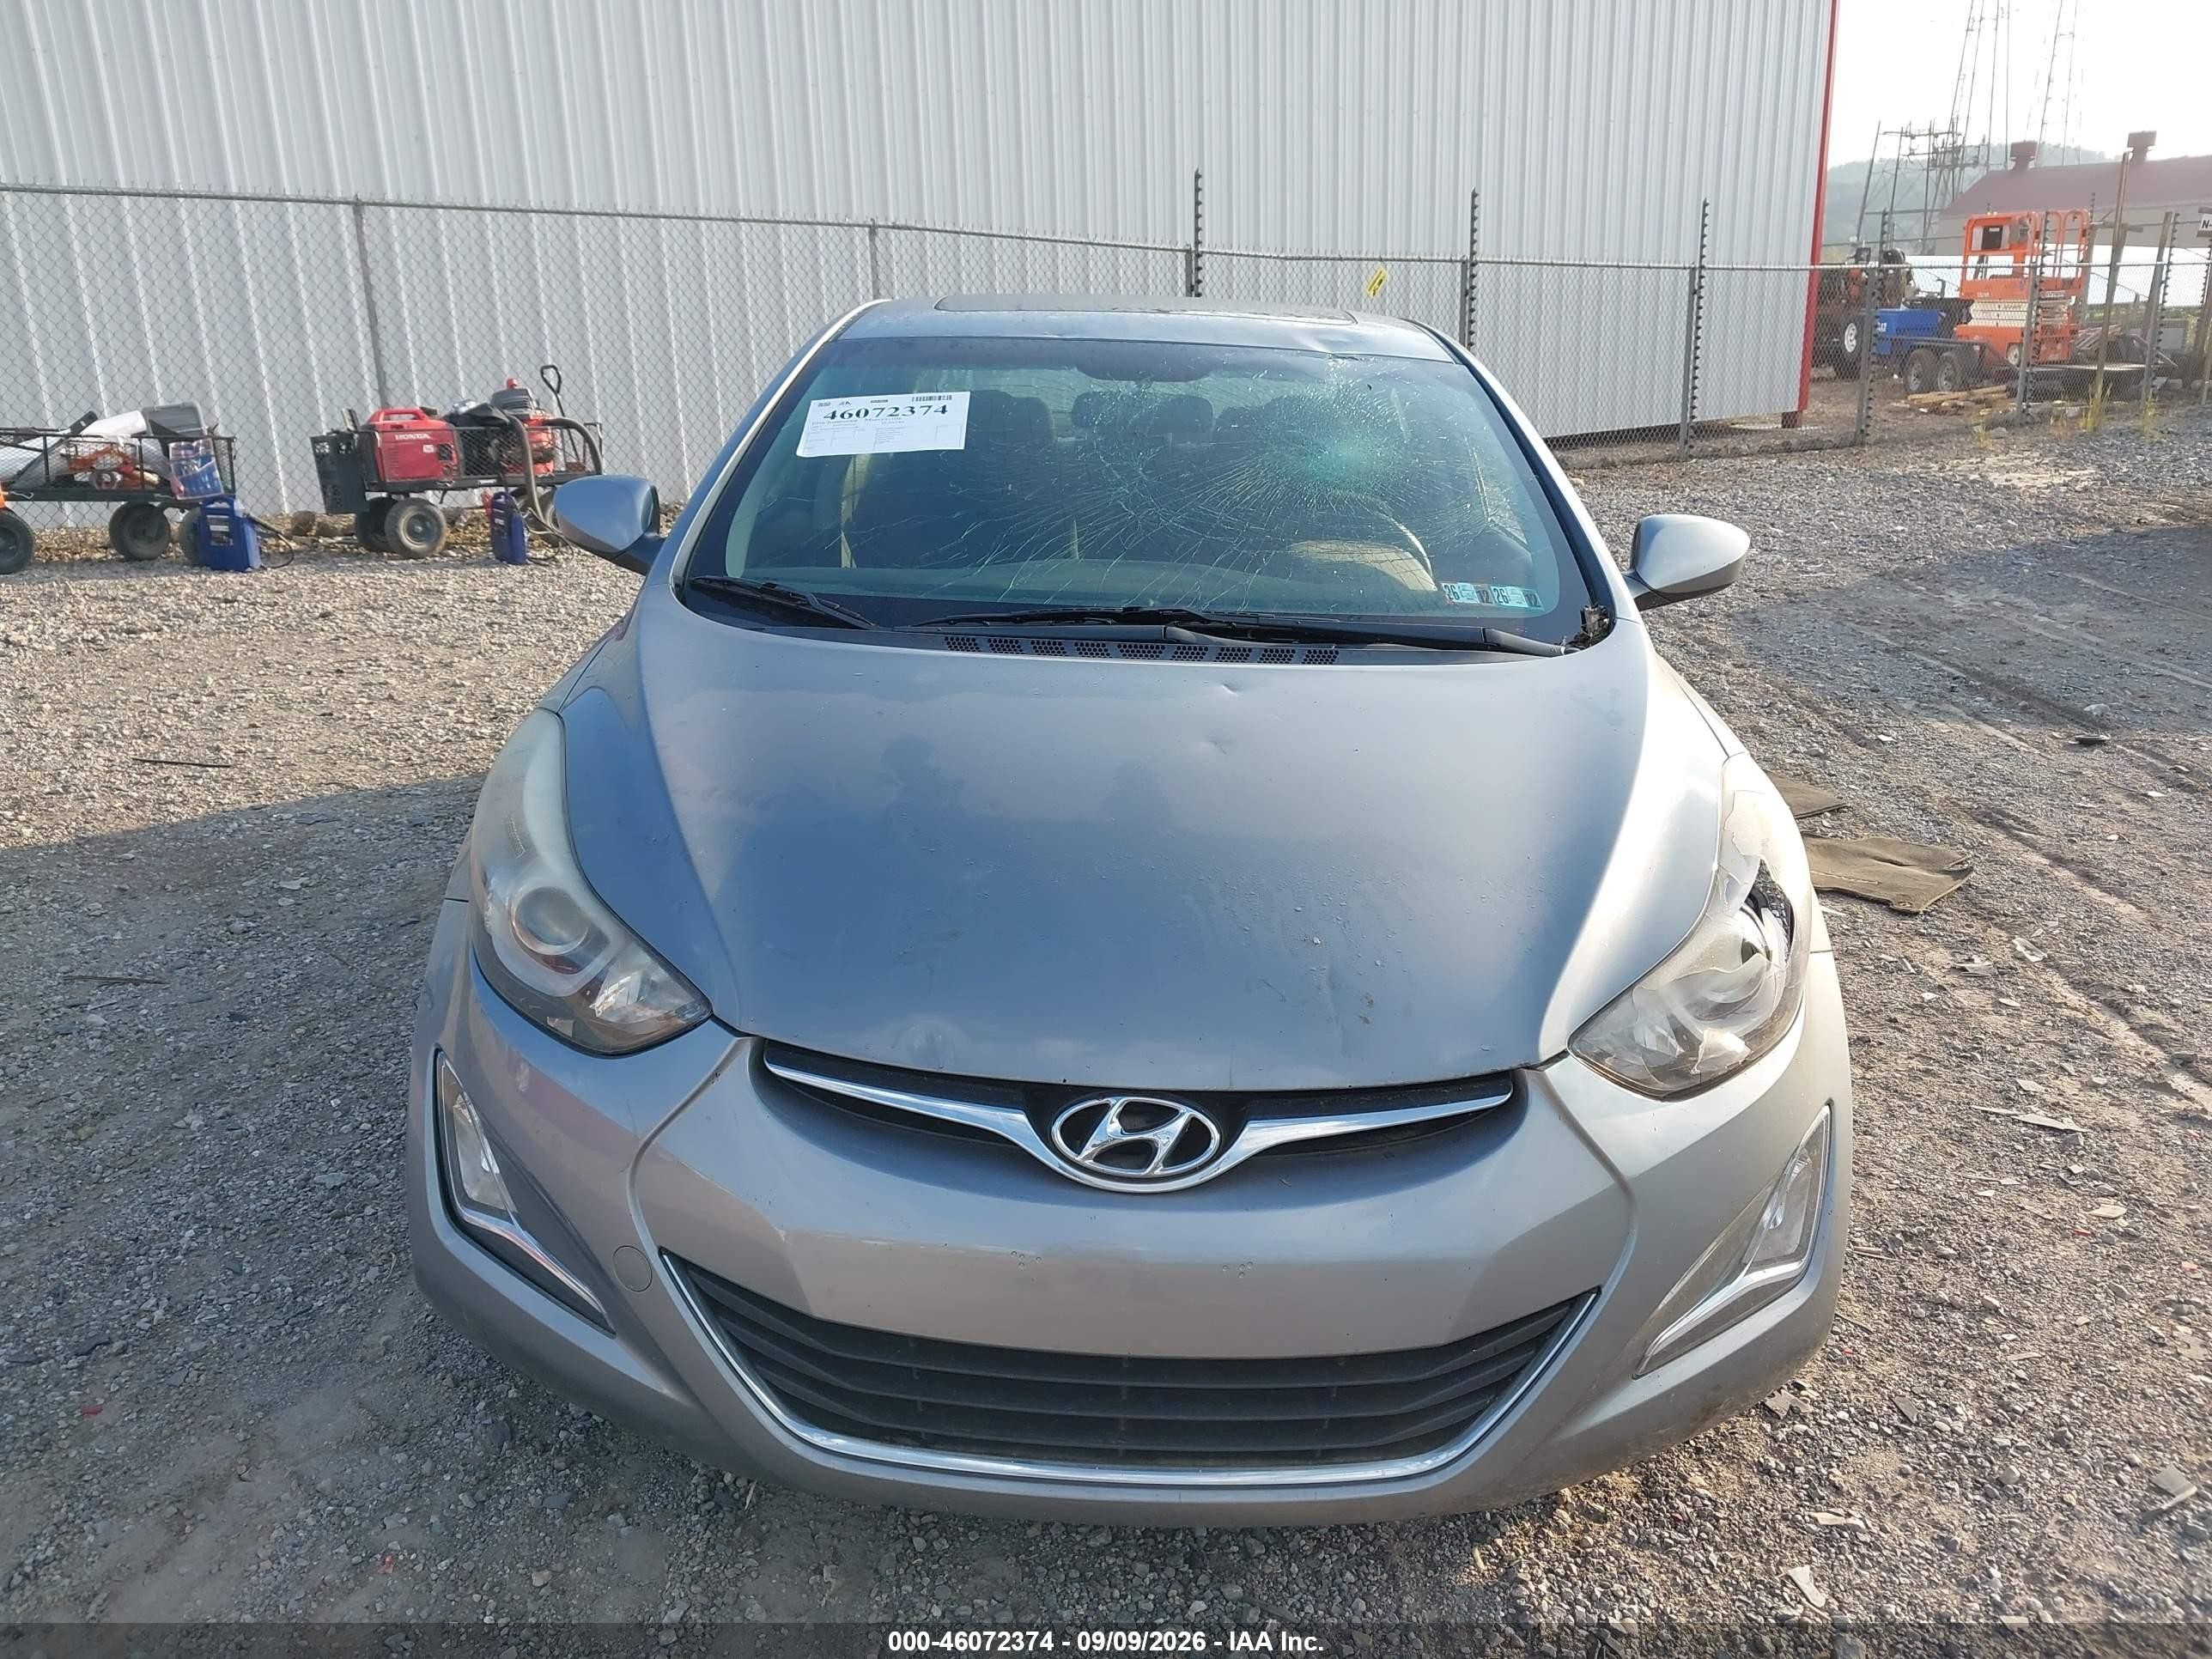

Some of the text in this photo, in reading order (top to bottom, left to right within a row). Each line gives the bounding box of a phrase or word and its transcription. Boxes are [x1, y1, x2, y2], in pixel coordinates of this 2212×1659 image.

[823, 404, 949, 421] 46072374
[1443, 584, 1461, 601] 26
[1492, 587, 1510, 605] 26
